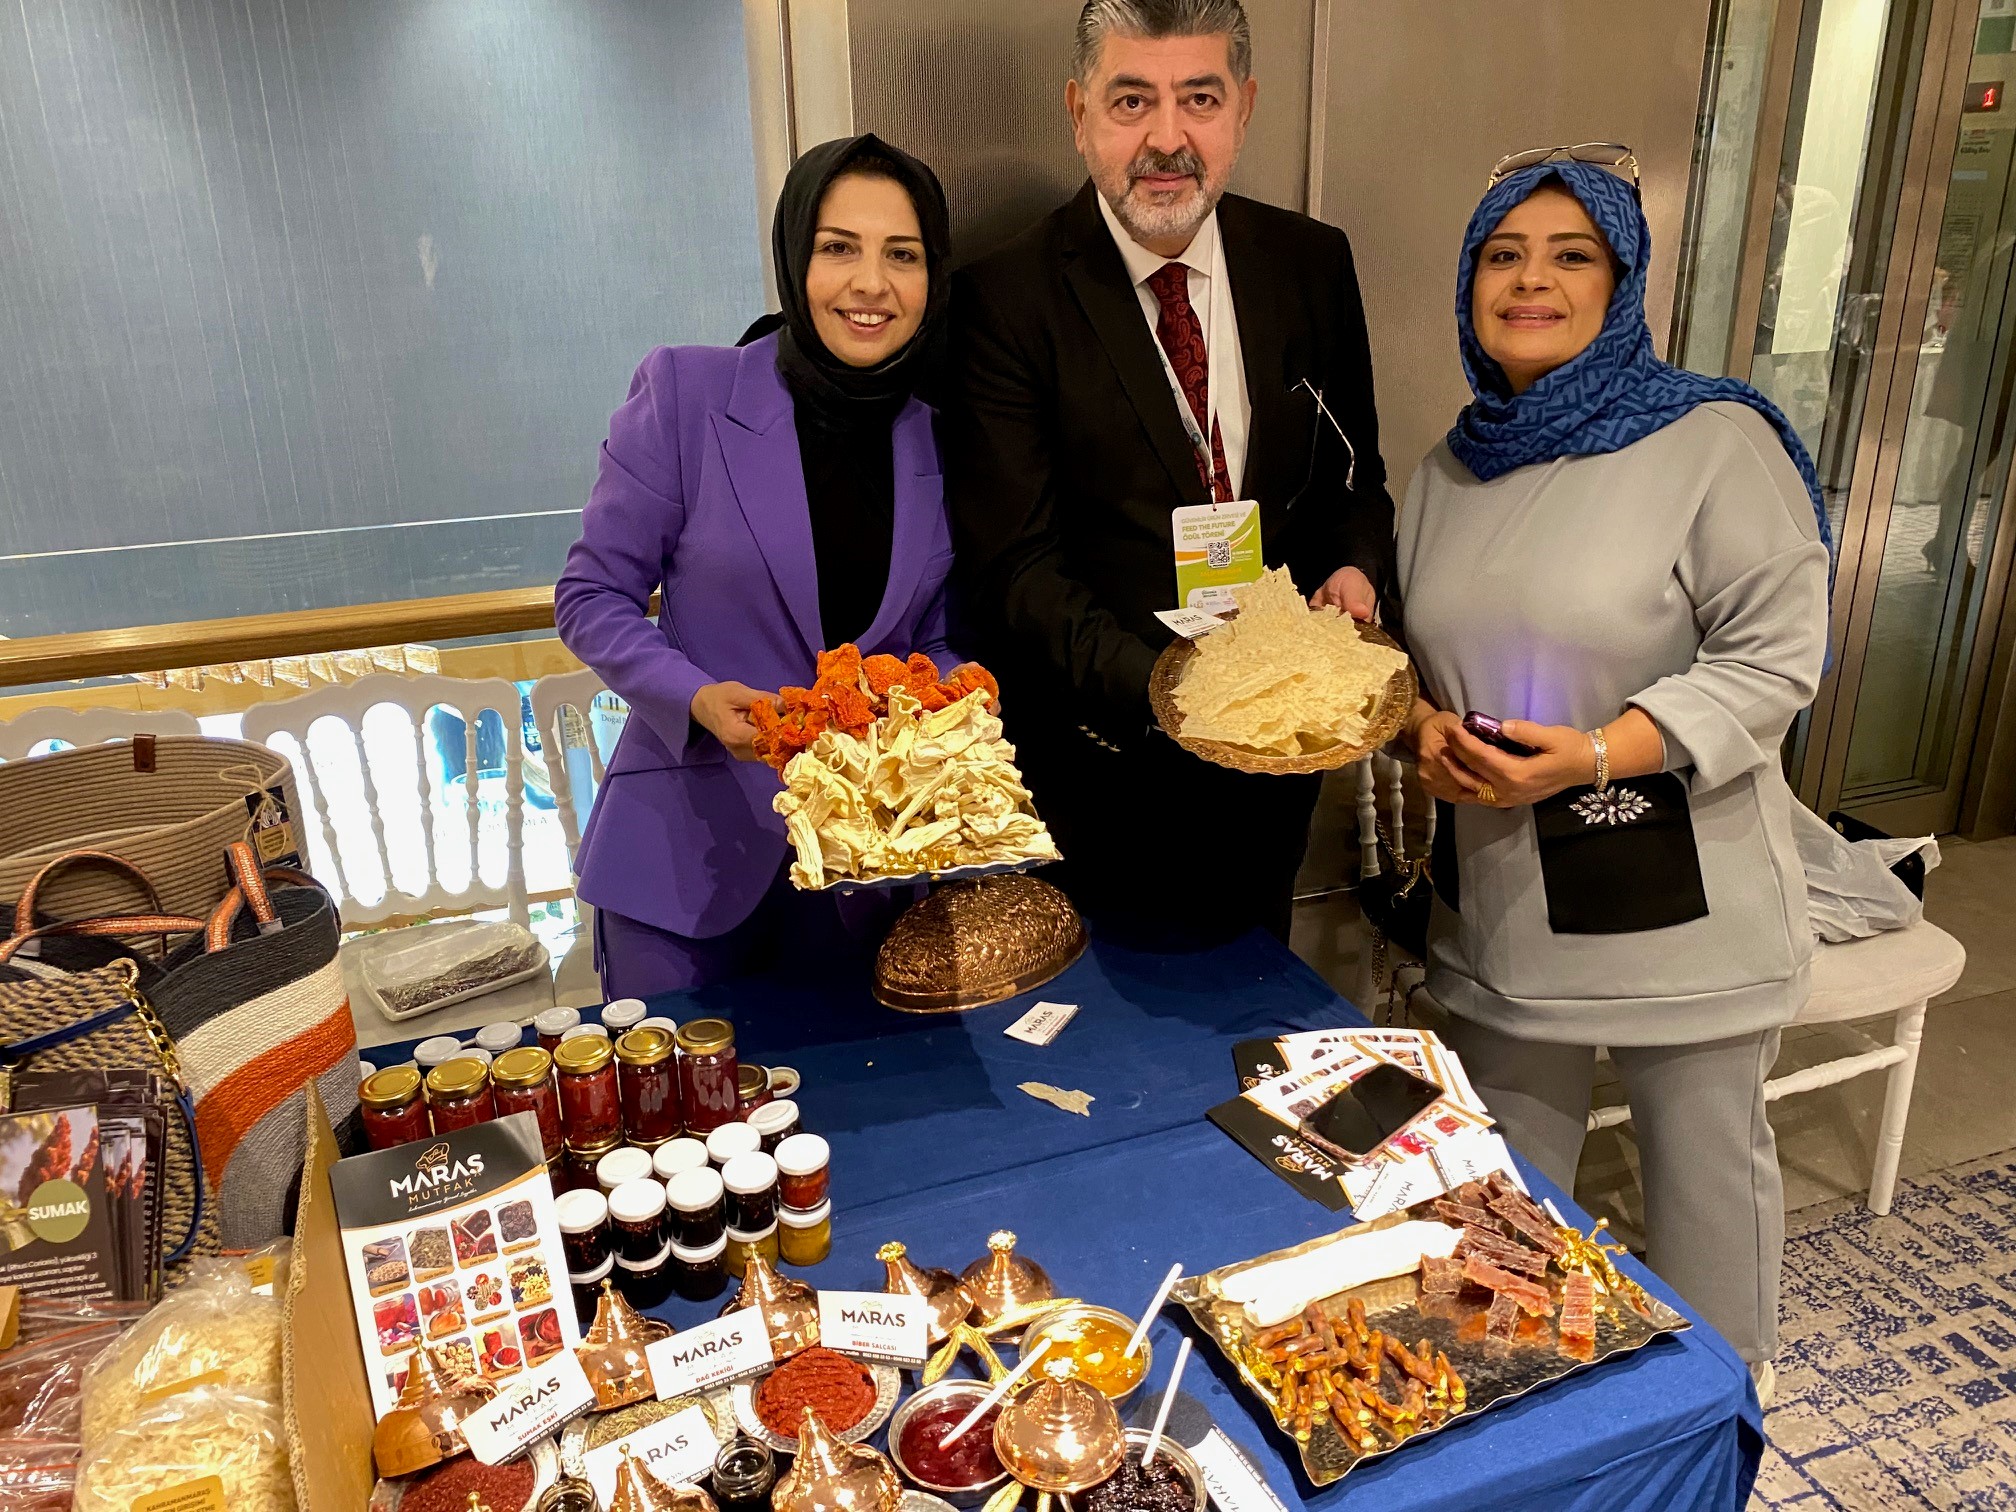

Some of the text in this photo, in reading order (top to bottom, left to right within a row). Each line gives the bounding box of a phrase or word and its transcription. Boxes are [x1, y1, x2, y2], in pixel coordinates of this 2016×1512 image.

[1982, 88, 1996, 107] 1
[1182, 520, 1236, 533] FEED THE FUTURE
[1271, 1134, 1334, 1181] MARAS
[389, 1154, 485, 1198] MARAS
[408, 1177, 474, 1204] MUTFAK
[29, 1200, 88, 1221] SUMAK
[841, 1309, 906, 1328] MARAS
[673, 1331, 743, 1367] MARAS
[490, 1377, 561, 1432] MARAS
[517, 1423, 542, 1442] SUMAK
[644, 1434, 689, 1465] RAS
